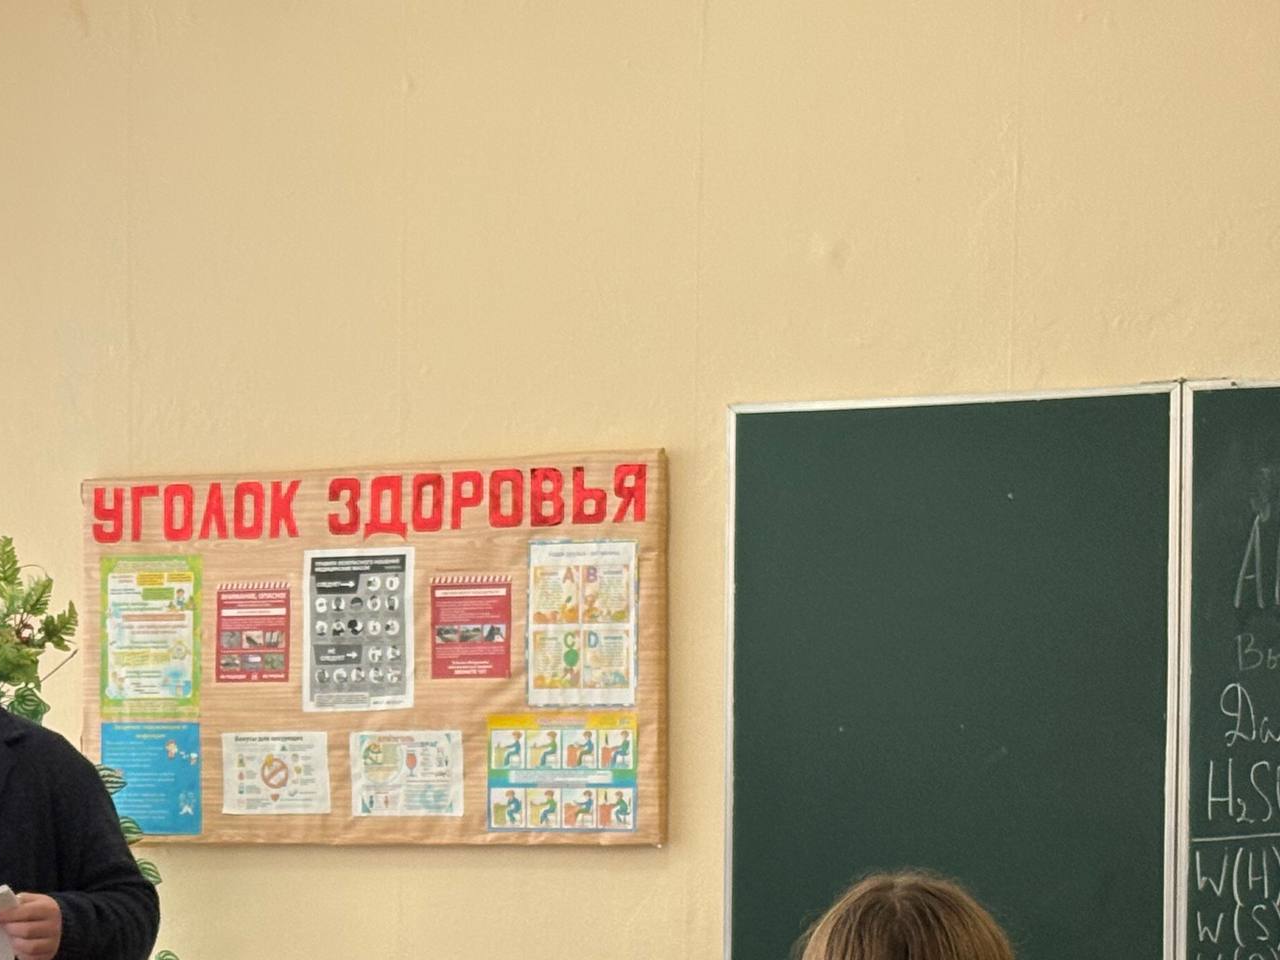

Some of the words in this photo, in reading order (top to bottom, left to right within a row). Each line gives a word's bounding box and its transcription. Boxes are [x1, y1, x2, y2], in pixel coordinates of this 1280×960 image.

[93, 480, 302, 543] УГОЛОК
[328, 464, 648, 541] ЗДОРОВЬЯ
[562, 567, 575, 584] A
[586, 567, 598, 584] B
[564, 631, 575, 648] C
[587, 630, 599, 648] D
[1208, 757, 1280, 822] H2S
